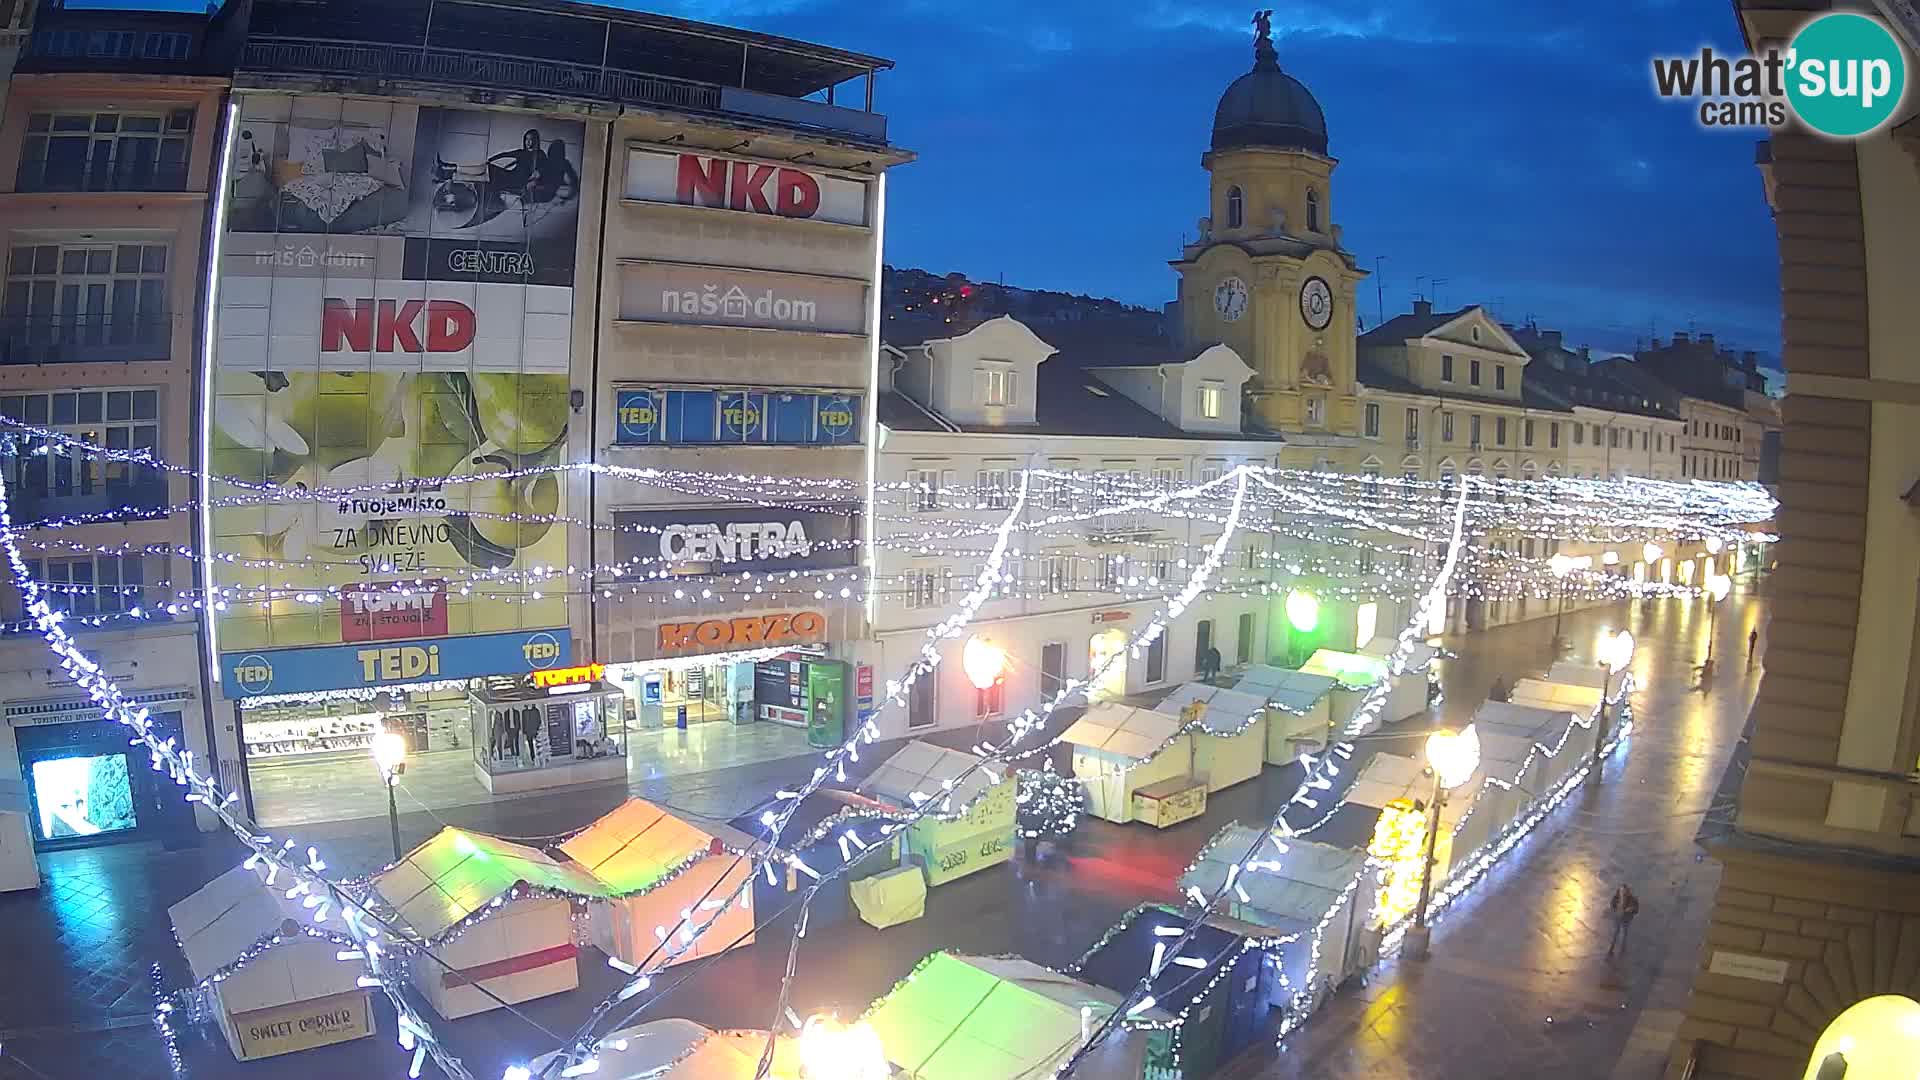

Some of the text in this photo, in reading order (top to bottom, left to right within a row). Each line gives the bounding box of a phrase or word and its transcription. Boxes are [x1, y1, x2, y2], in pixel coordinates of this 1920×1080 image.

[676, 152, 820, 219] NKD
[448, 249, 535, 275] CENTRA
[661, 283, 816, 322] naš dom
[320, 297, 477, 353] NKD
[338, 497, 446, 515] #TvojeMisto
[334, 524, 450, 548] ZA DNEVNO
[659, 520, 810, 562] CENTRA
[360, 547, 425, 575] SVJEŽE
[660, 612, 825, 650] KORZO
[358, 645, 440, 682] TEDi
[250, 1020, 292, 1041] SWEET
